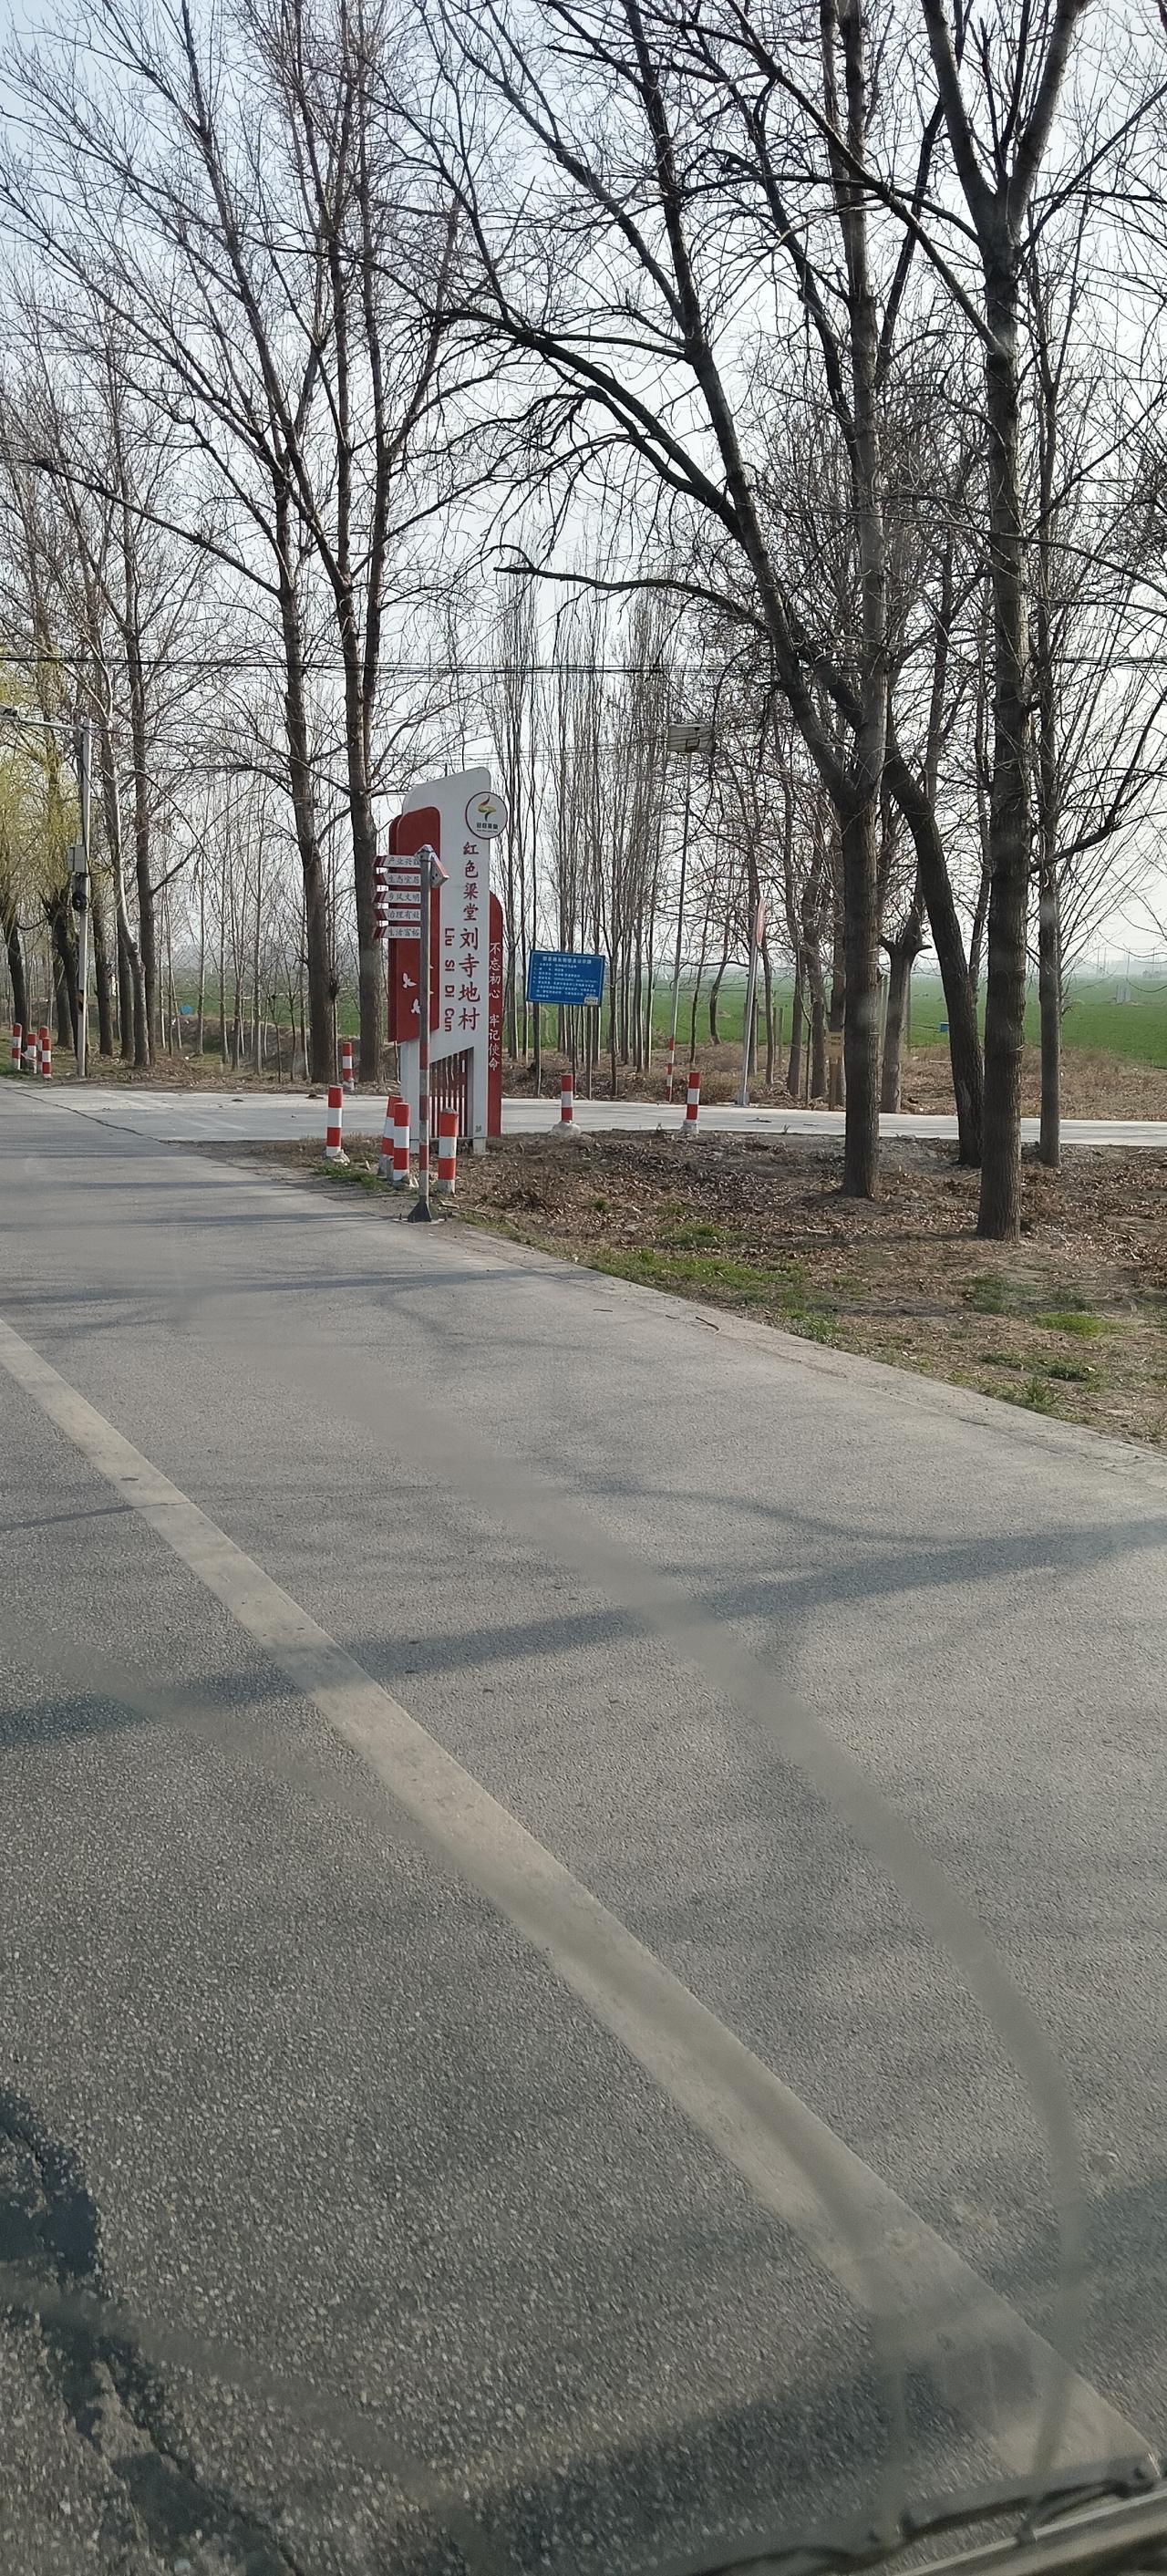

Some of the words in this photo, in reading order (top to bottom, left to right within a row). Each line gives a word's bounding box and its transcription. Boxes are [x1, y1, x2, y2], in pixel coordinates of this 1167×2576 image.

[463, 842, 479, 921] 红色梁堂
[445, 927, 455, 947] Liu
[458, 926, 480, 1031] 刘寺地村
[489, 942, 501, 998] 不忘初心
[444, 1008, 455, 1032] Cun
[488, 1014, 501, 1071] 牢记使命
